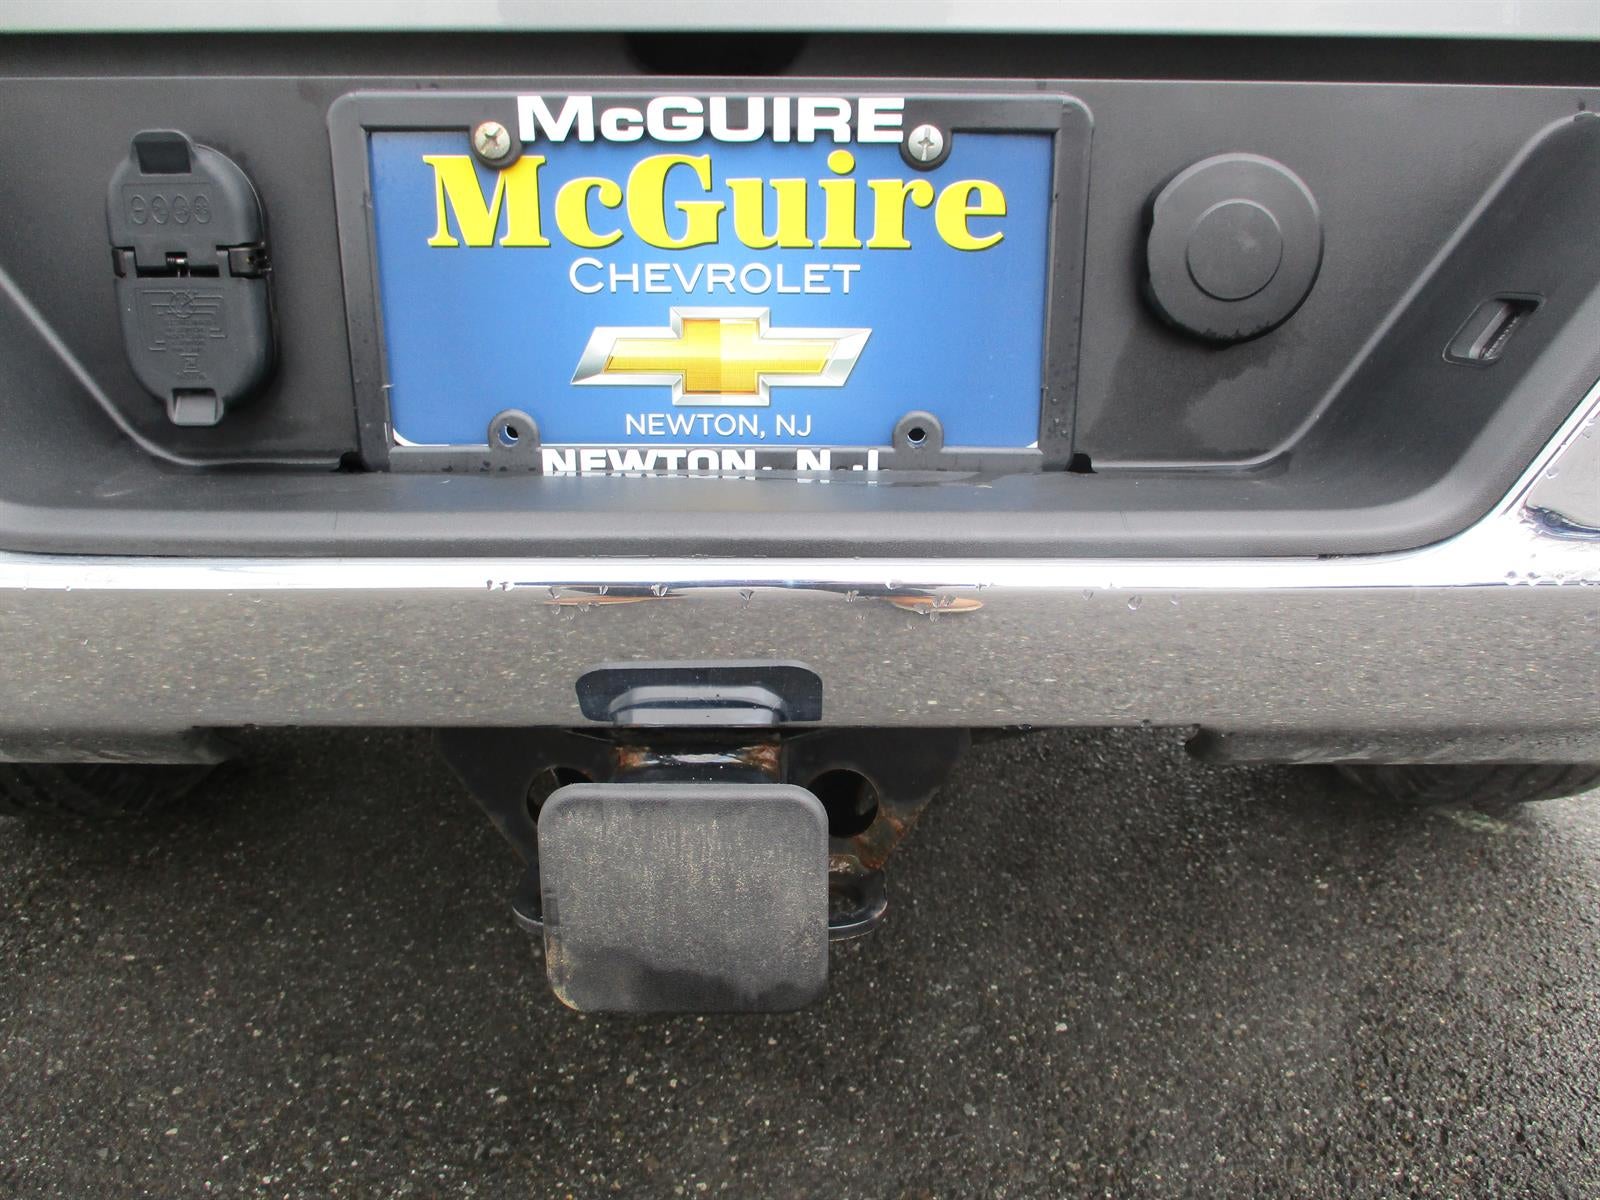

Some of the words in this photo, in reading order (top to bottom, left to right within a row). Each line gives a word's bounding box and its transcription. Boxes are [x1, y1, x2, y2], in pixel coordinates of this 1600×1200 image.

[517, 95, 905, 143] McGUIRE
[422, 149, 1008, 251] McGuire
[569, 257, 861, 294] CHEVROLET
[625, 413, 766, 439] NEWTON,
[776, 414, 812, 437] NJ
[541, 448, 773, 473] NEWTON
